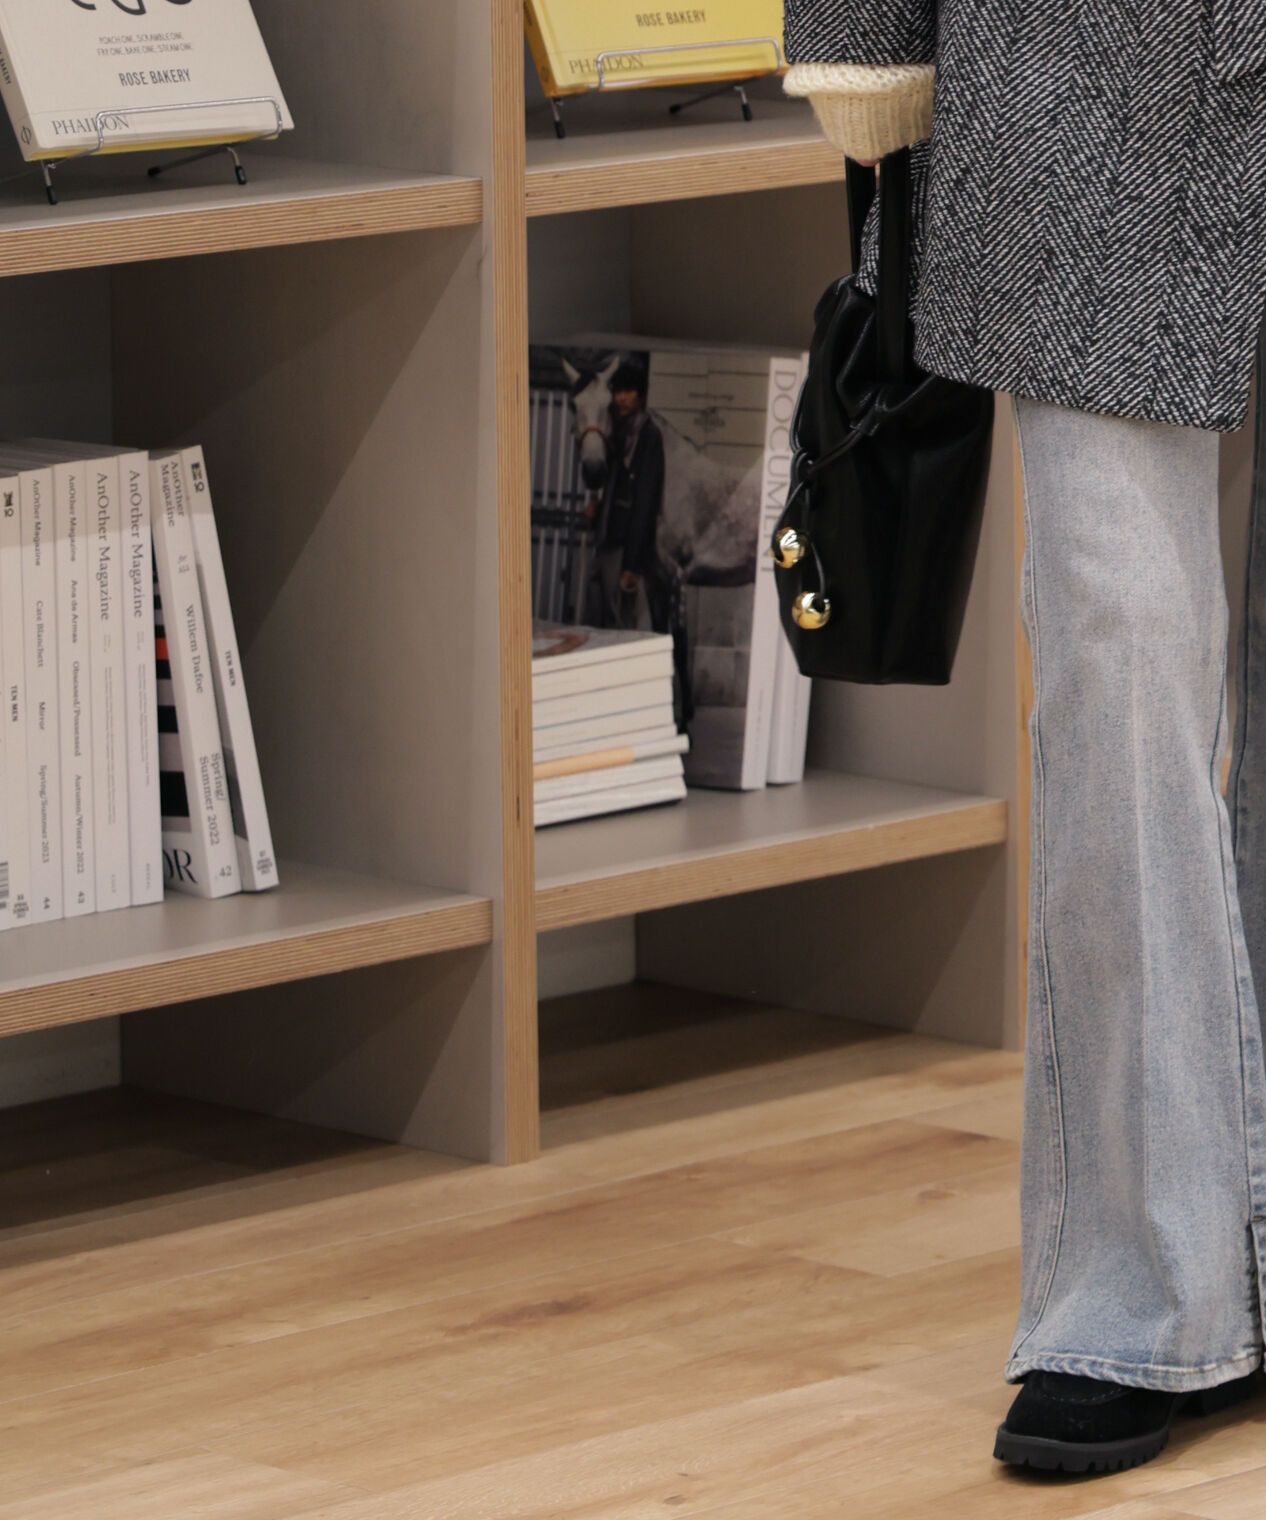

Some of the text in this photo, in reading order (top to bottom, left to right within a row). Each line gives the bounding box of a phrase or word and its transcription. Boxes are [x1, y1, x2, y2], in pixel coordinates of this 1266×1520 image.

[635, 9, 707, 28] ROSE BAKERY
[118, 68, 191, 87] ROSE BAKERY
[568, 53, 645, 75] PHAIDON
[51, 114, 131, 135] PHAIDON
[32, 479, 40, 518] AnOther
[97, 472, 111, 541] AnOther
[129, 469, 140, 538] AnOther
[161, 464, 175, 528] Magazine
[171, 461, 185, 517] AnOther
[33, 521, 41, 566] Magazine
[68, 517, 76, 562] Magazine
[71, 596, 78, 610] de
[96, 546, 112, 620] Magazine
[129, 543, 145, 618] Magazine
[185, 604, 204, 694] Willem Dafoe
[10, 685, 18, 701] TEN
[228, 668, 236, 687] MEN
[211, 752, 225, 801] Spring/
[75, 774, 84, 851] Autumn/Winter
[200, 755, 220, 846] Summer 2022
[43, 896, 50, 910] 44
[77, 891, 84, 904] 43
